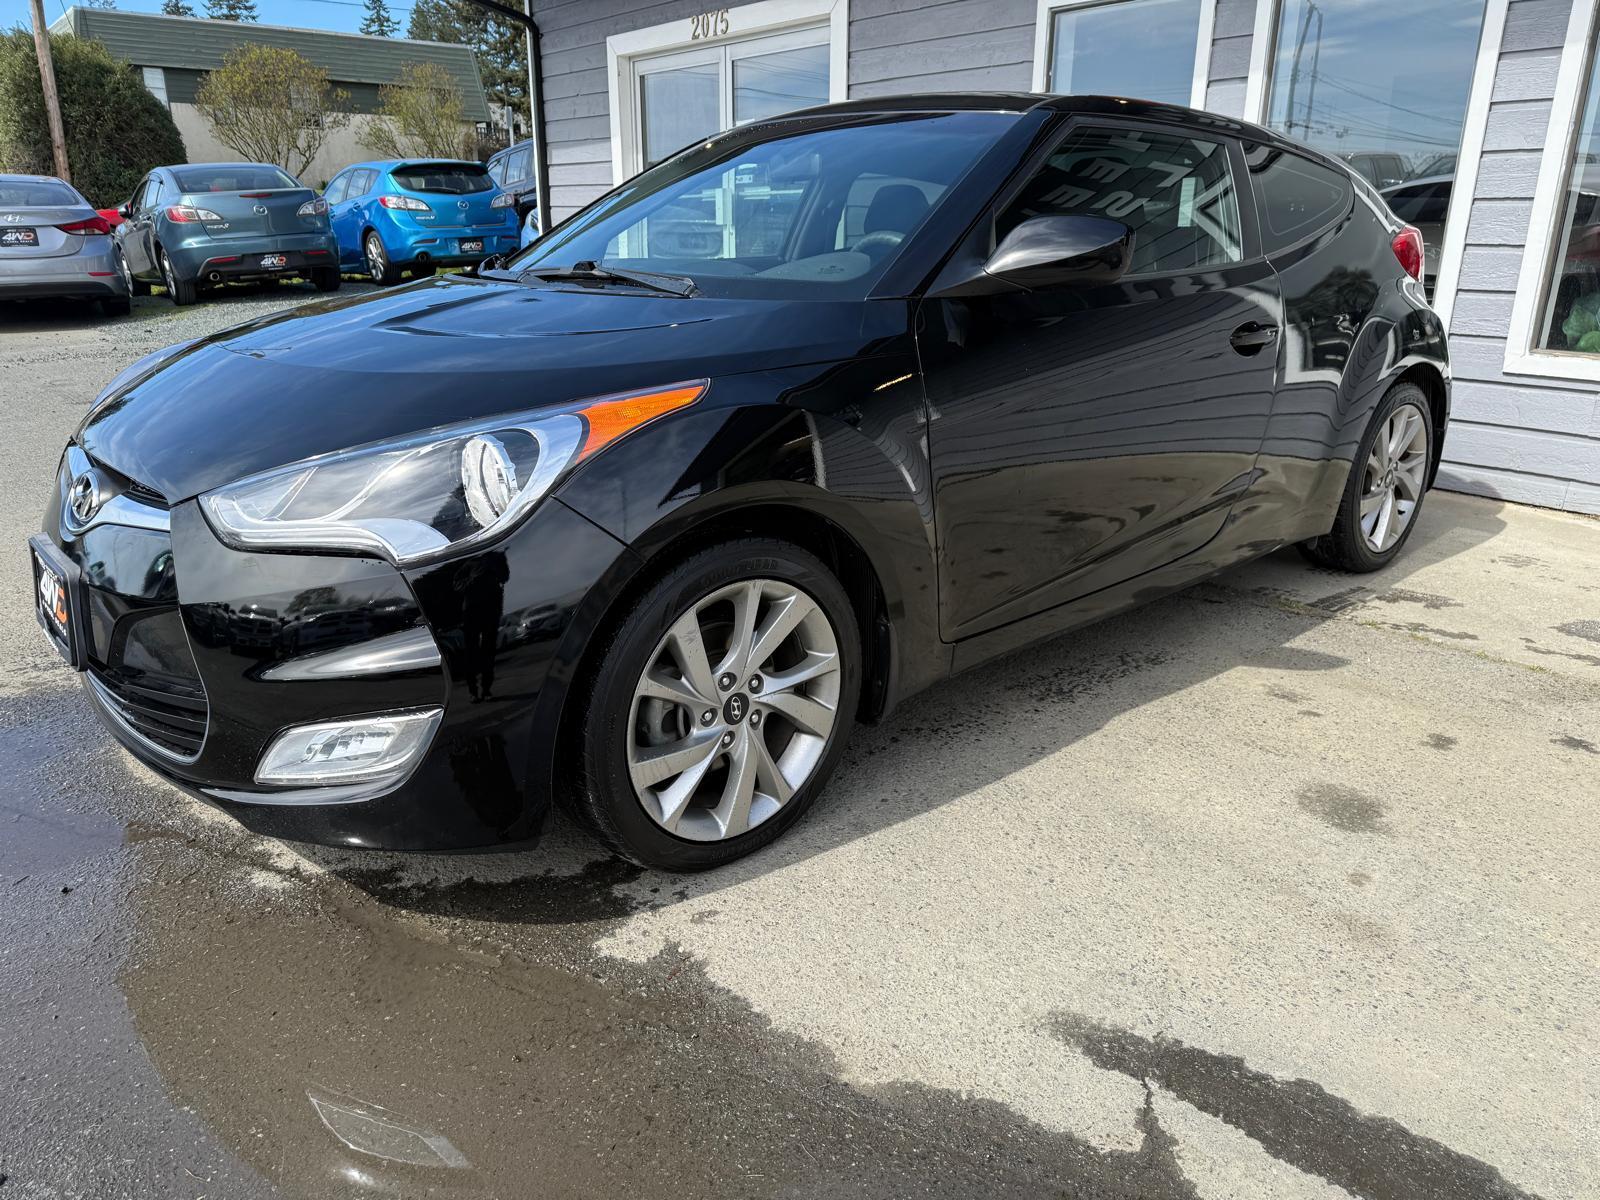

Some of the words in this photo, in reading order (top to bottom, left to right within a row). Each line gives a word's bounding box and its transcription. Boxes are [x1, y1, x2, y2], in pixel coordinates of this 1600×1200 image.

[690, 8, 730, 40] 2075
[2, 232, 35, 241] 4WD
[461, 241, 482, 249] 4WD
[260, 255, 286, 265] 4WD
